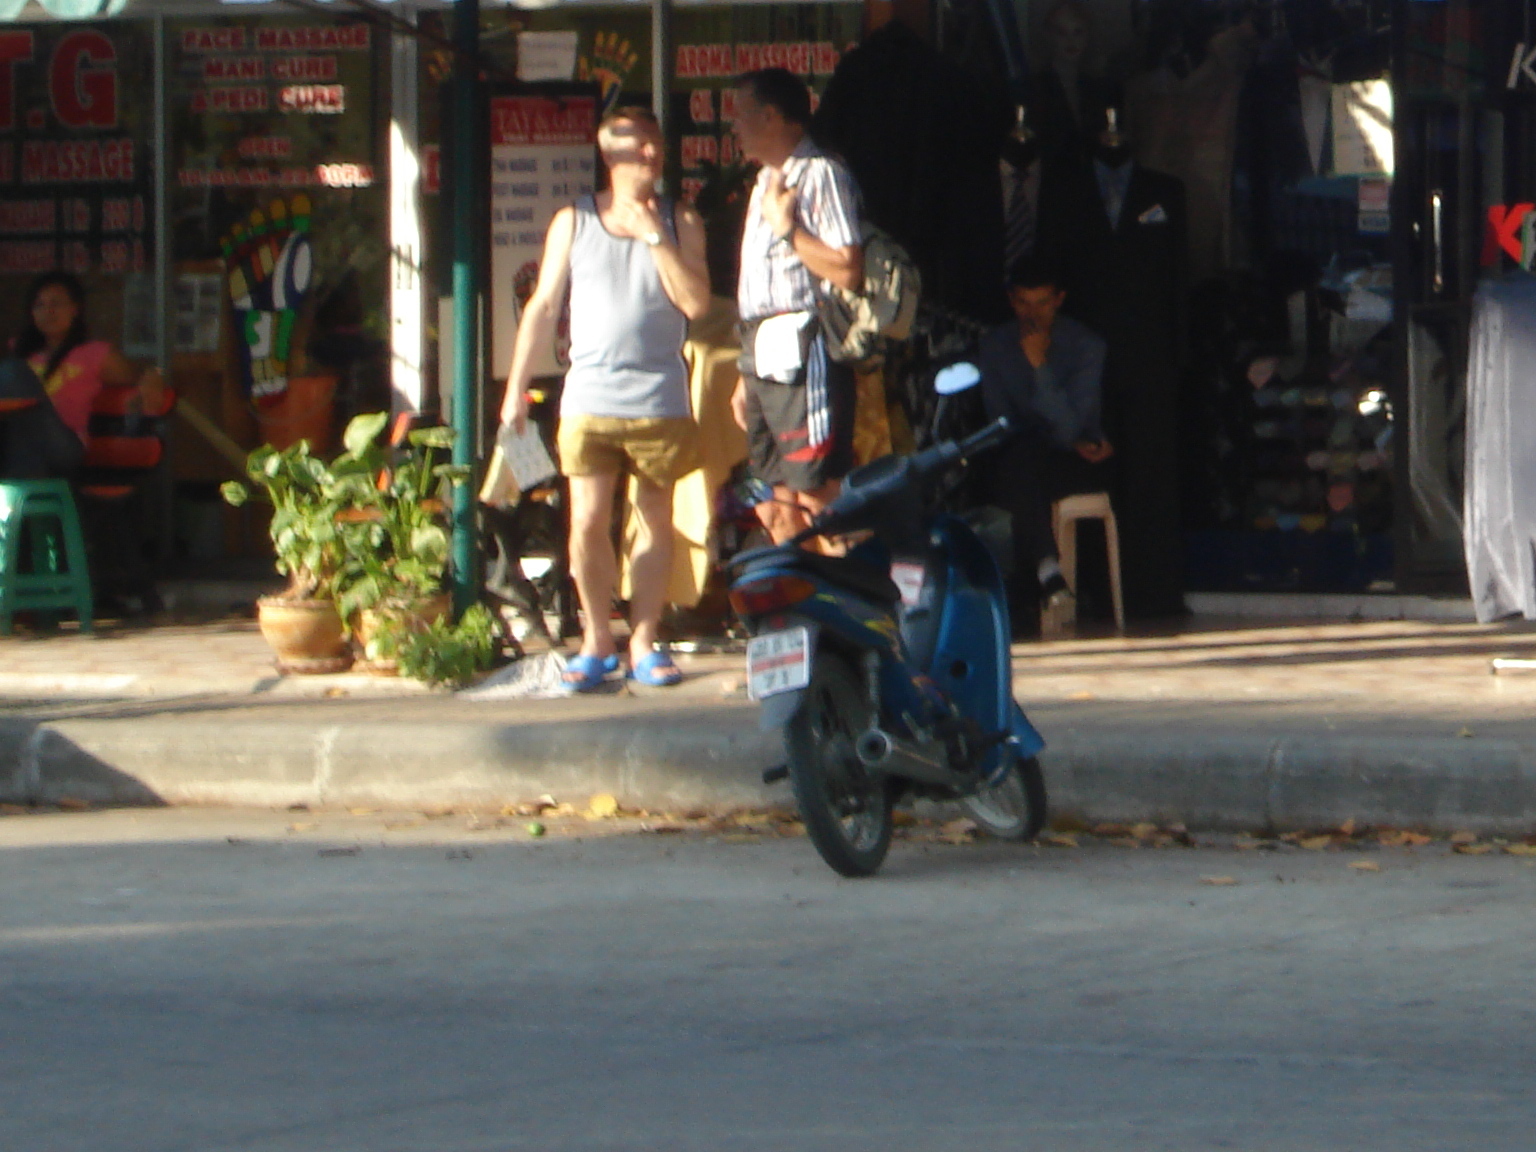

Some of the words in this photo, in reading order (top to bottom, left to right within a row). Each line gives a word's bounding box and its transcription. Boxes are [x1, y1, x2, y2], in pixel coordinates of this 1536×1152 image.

[182, 27, 246, 51] FACE
[256, 23, 371, 50] MASSAGE
[202, 56, 265, 80] MANI
[271, 55, 337, 79] CURE
[676, 43, 734, 79] AROMA
[735, 41, 811, 75] MASSAGE
[210, 86, 268, 111] PEDI
[278, 84, 345, 114] CURE
[21, 137, 135, 184] MASSAGE
